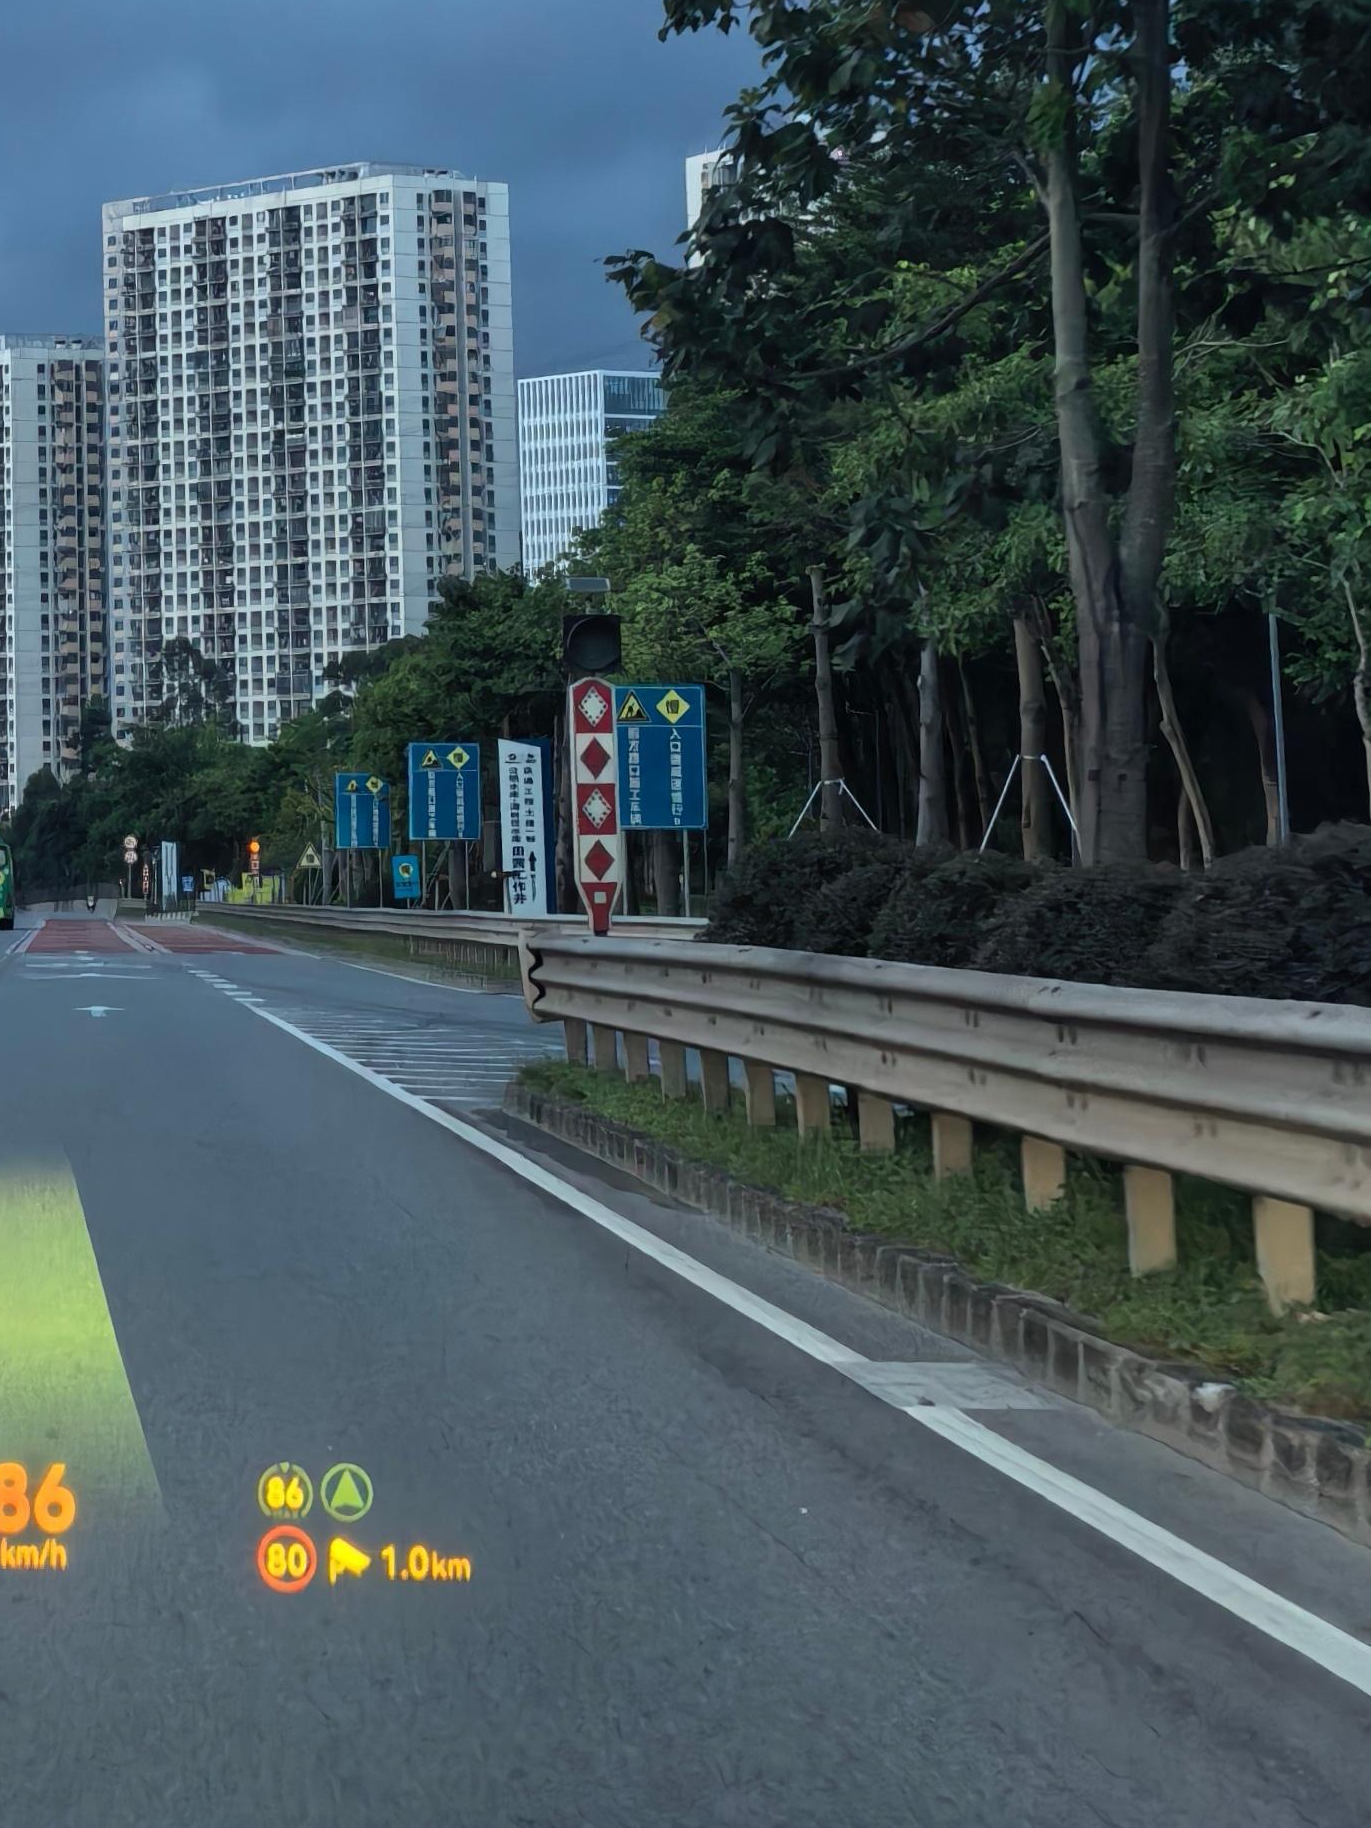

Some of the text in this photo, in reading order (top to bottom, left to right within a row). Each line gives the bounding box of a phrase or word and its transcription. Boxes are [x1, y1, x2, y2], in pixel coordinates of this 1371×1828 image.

[266, 1476, 304, 1510] 86
[0, 1538, 67, 1570] km/h
[267, 1542, 308, 1578] 80
[381, 1543, 472, 1582] 1.0km
